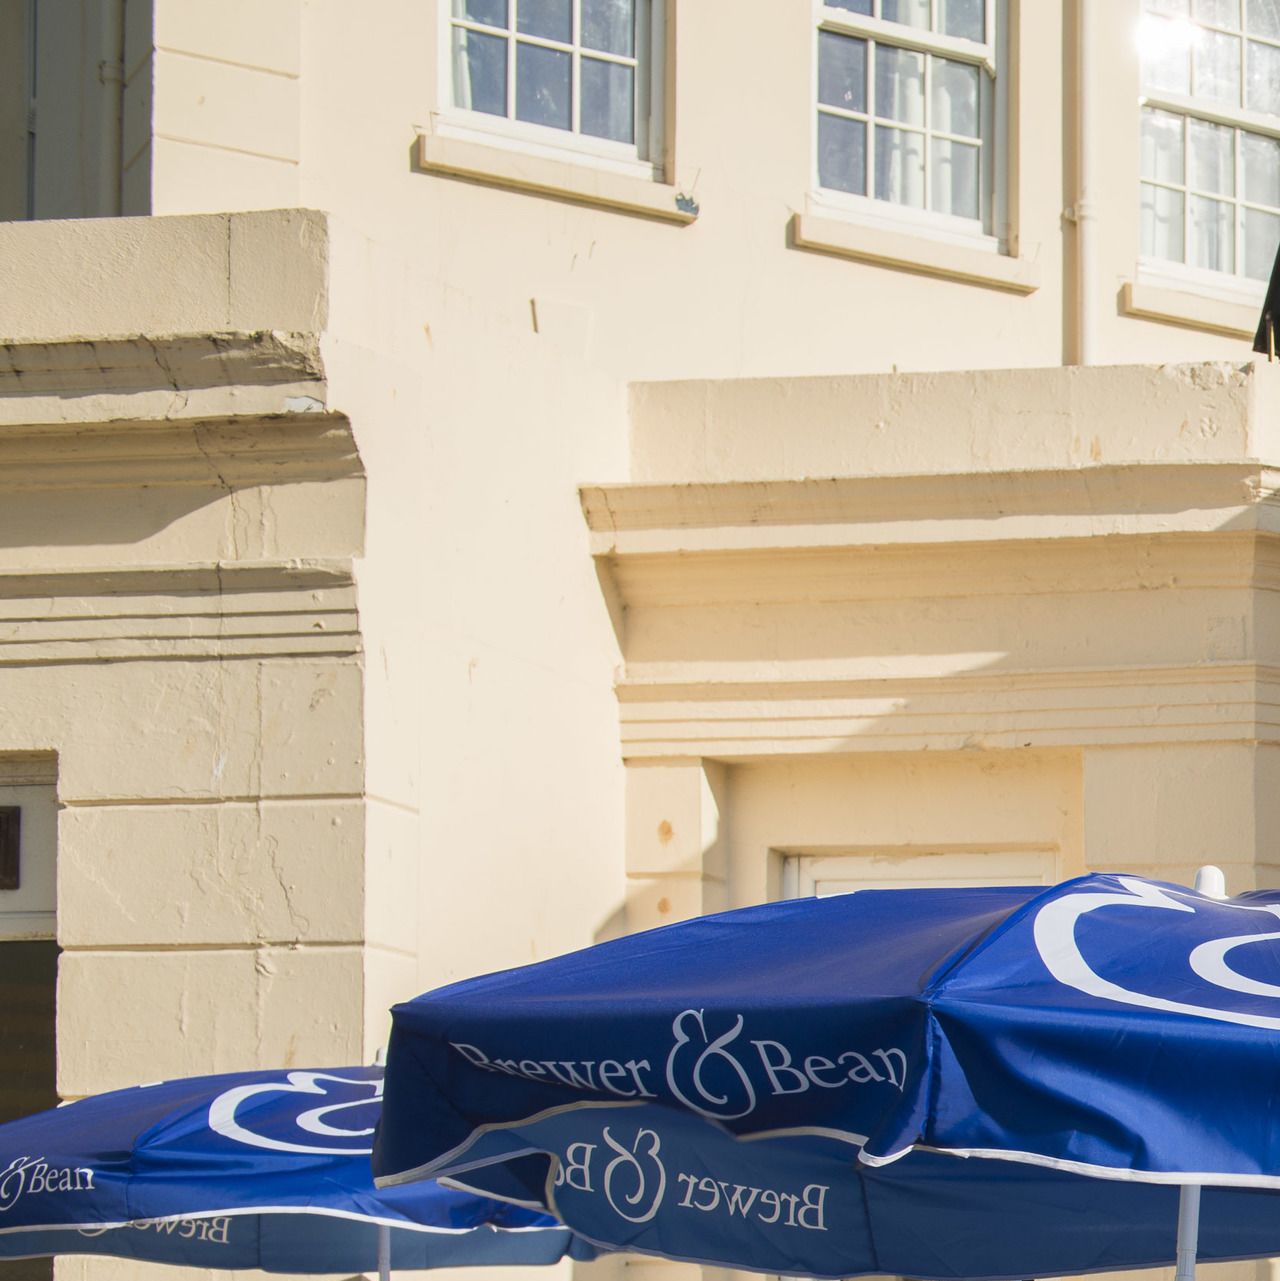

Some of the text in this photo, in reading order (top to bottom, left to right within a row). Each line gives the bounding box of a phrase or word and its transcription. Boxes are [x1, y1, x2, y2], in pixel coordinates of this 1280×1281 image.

[449, 1008, 908, 1120] Brewer & Bean
[27, 1163, 96, 1194] Bean
